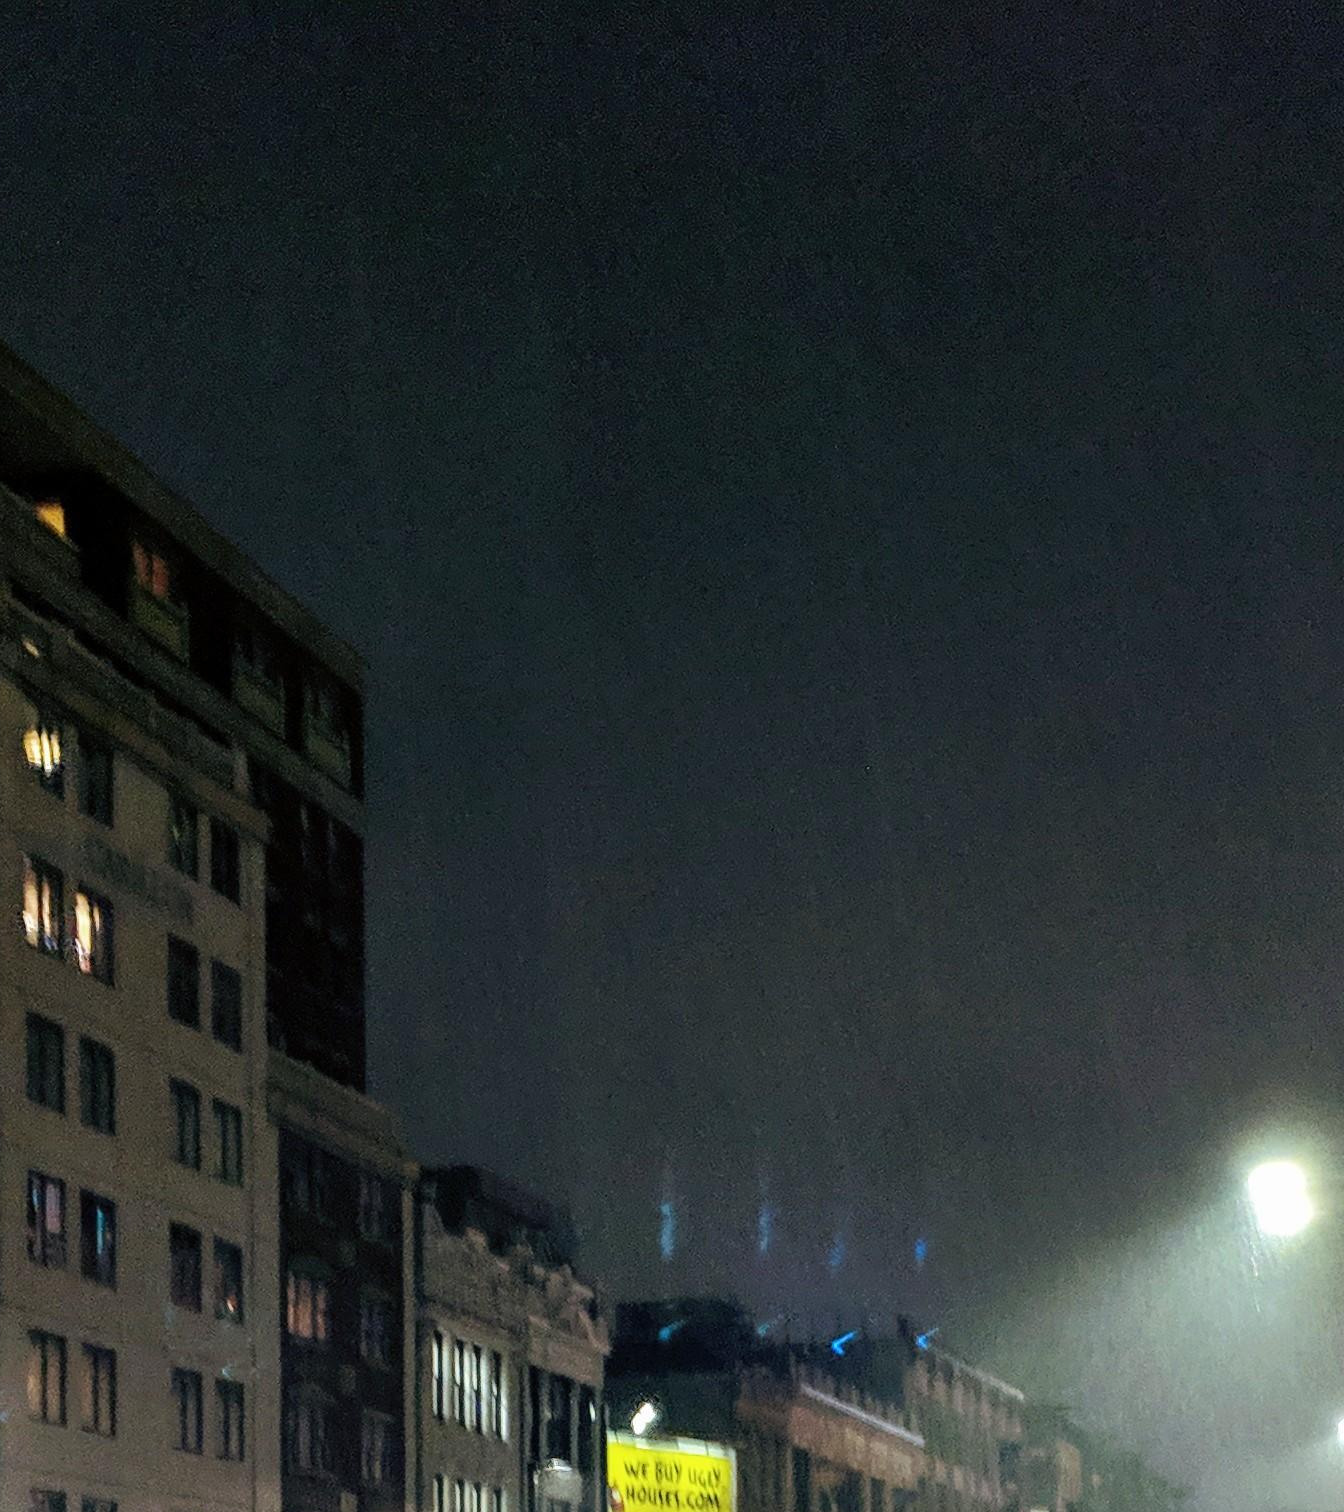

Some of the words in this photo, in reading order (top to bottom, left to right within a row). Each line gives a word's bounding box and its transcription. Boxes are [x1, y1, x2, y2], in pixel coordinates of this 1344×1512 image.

[624, 1461, 649, 1478] WE
[656, 1462, 681, 1483] BUY
[689, 1467, 721, 1489] UGLY
